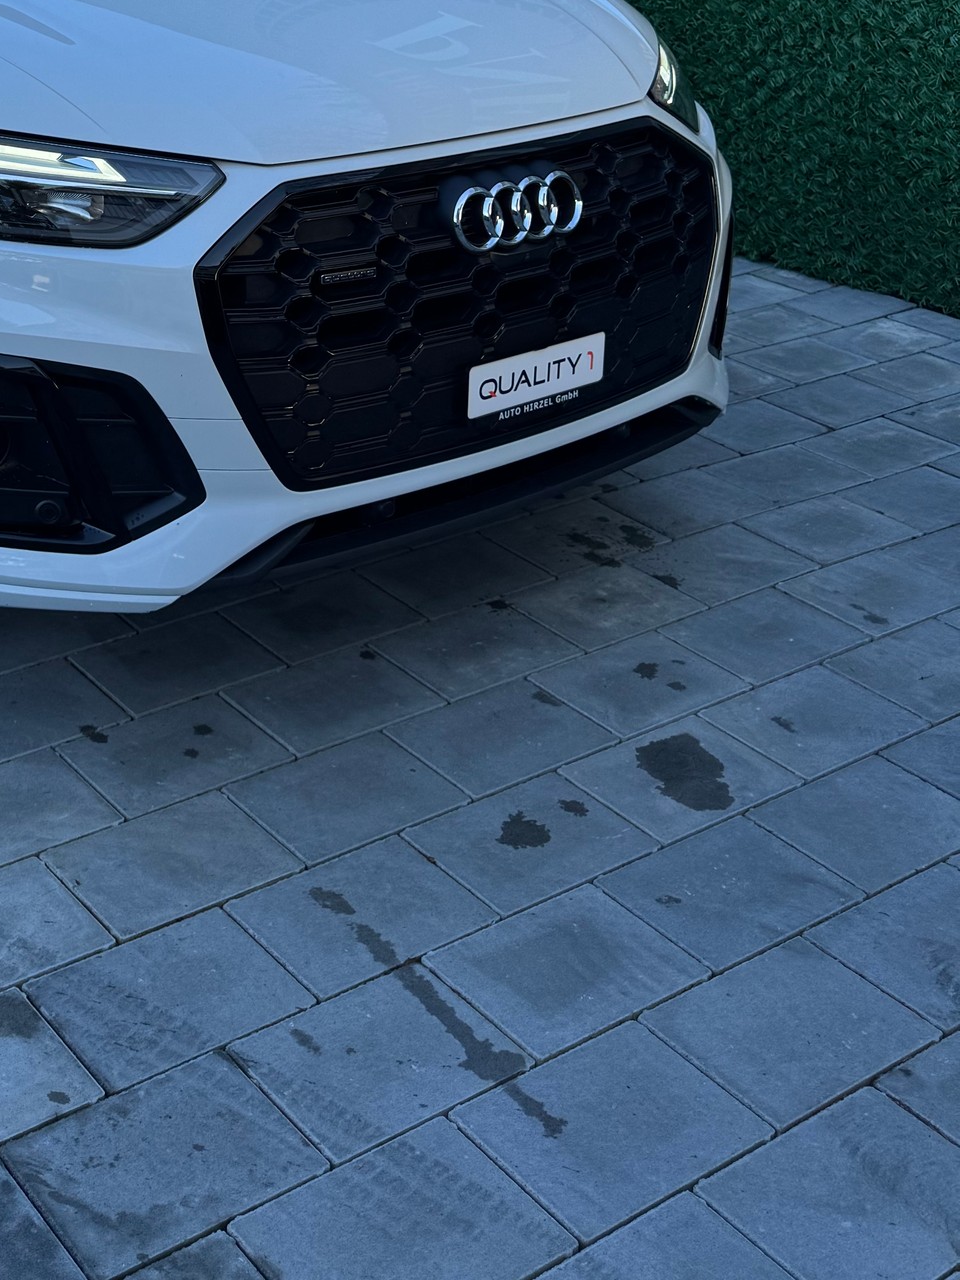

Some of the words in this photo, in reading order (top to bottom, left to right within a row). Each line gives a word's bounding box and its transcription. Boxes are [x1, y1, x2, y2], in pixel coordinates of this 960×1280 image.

[479, 353, 582, 400] QUALITY
[498, 409, 521, 420] AUTO
[523, 399, 553, 413] HIRZEL
[555, 389, 579, 403] GmbH
